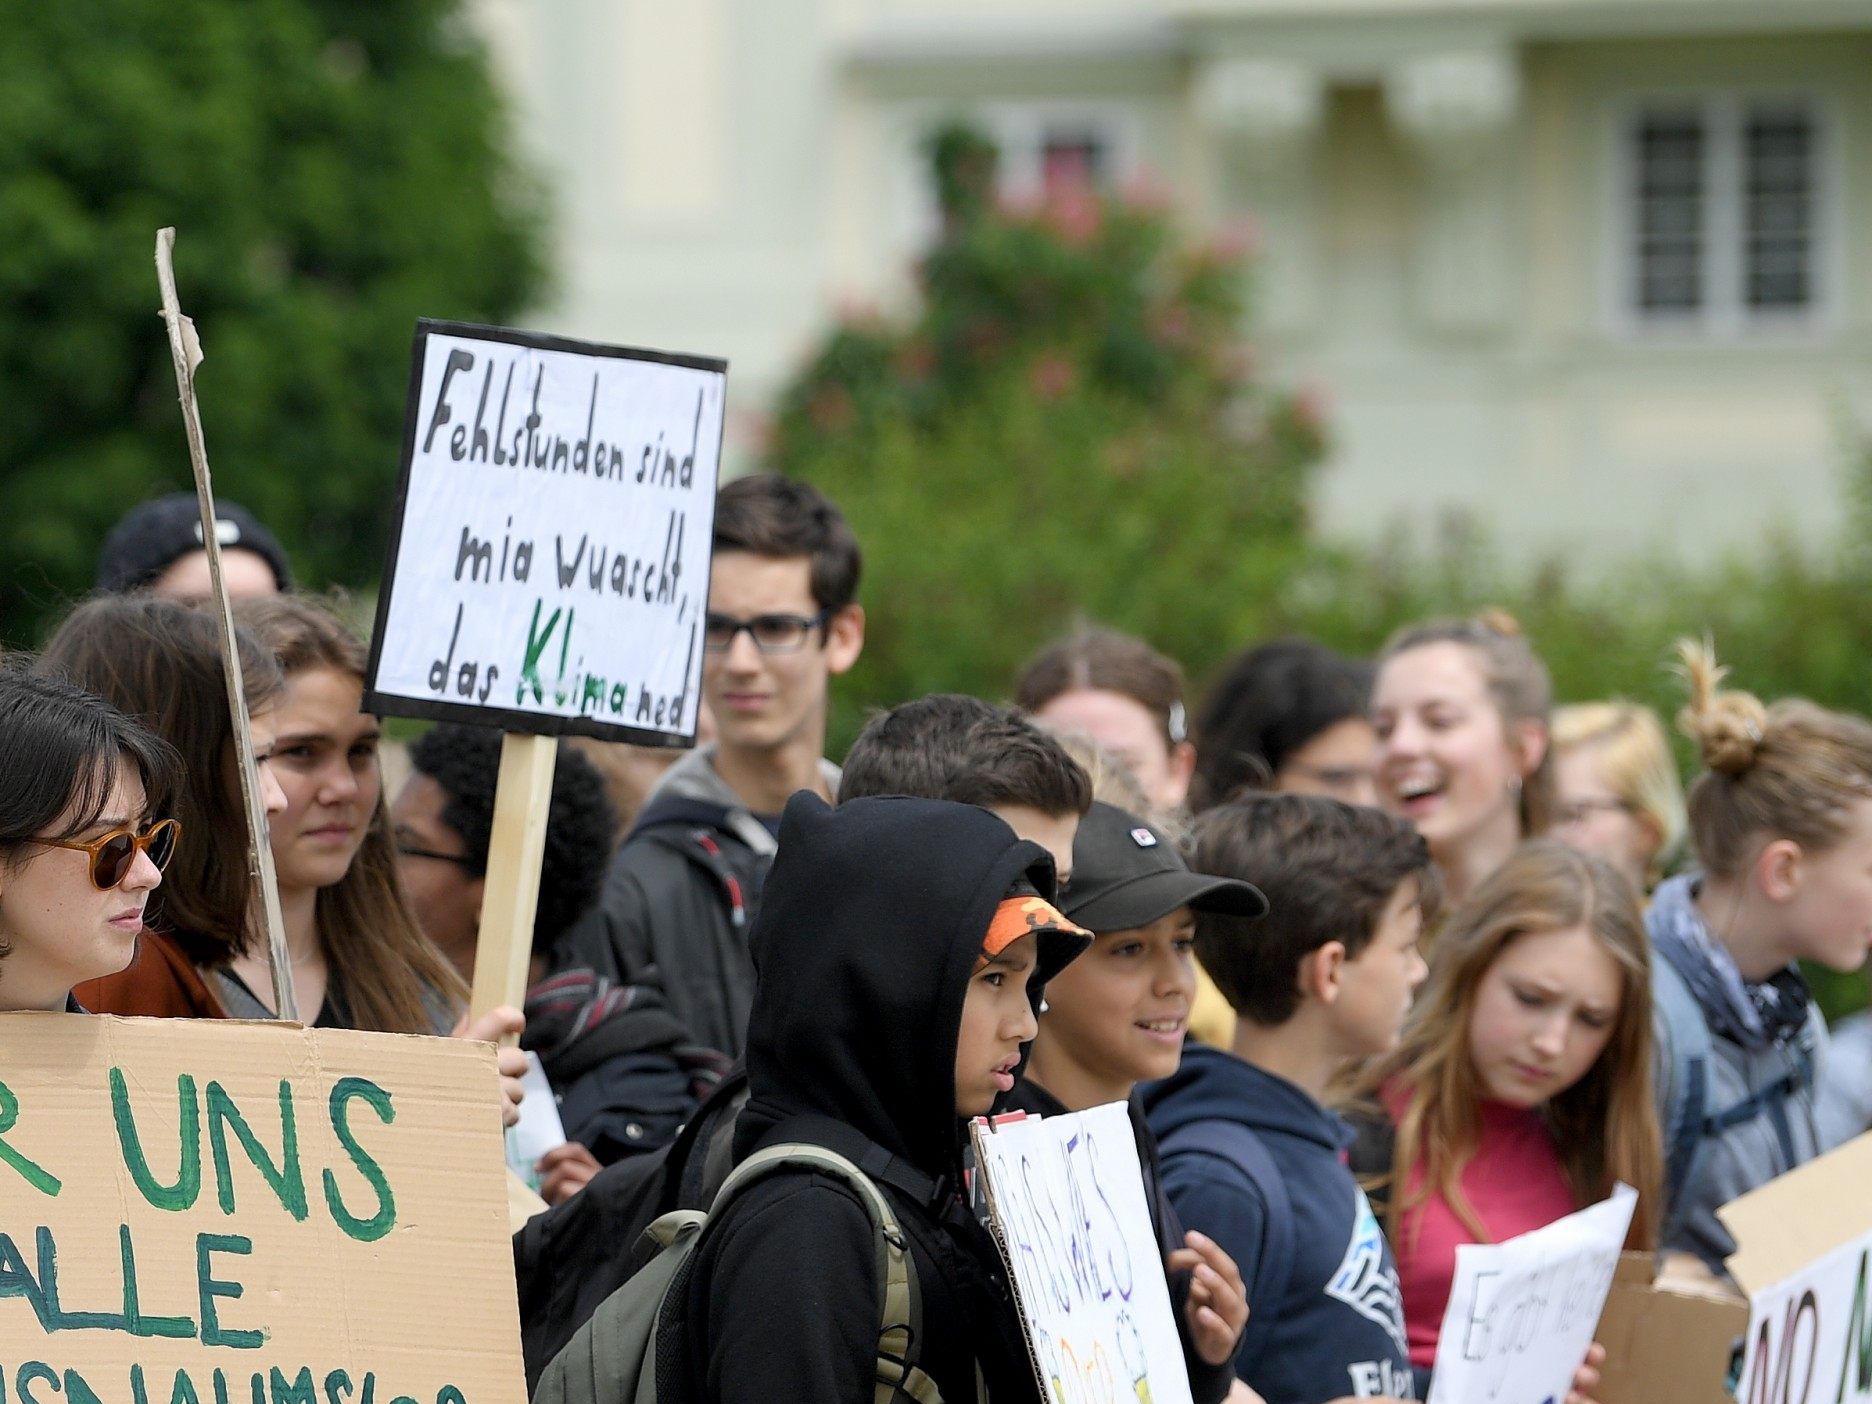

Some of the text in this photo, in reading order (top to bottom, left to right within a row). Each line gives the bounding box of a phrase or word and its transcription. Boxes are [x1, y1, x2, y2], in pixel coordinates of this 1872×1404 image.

[636, 386, 704, 490] sind
[454, 515, 535, 584] mia
[429, 597, 697, 729] das Klima ned
[107, 1065, 396, 1242] UNS
